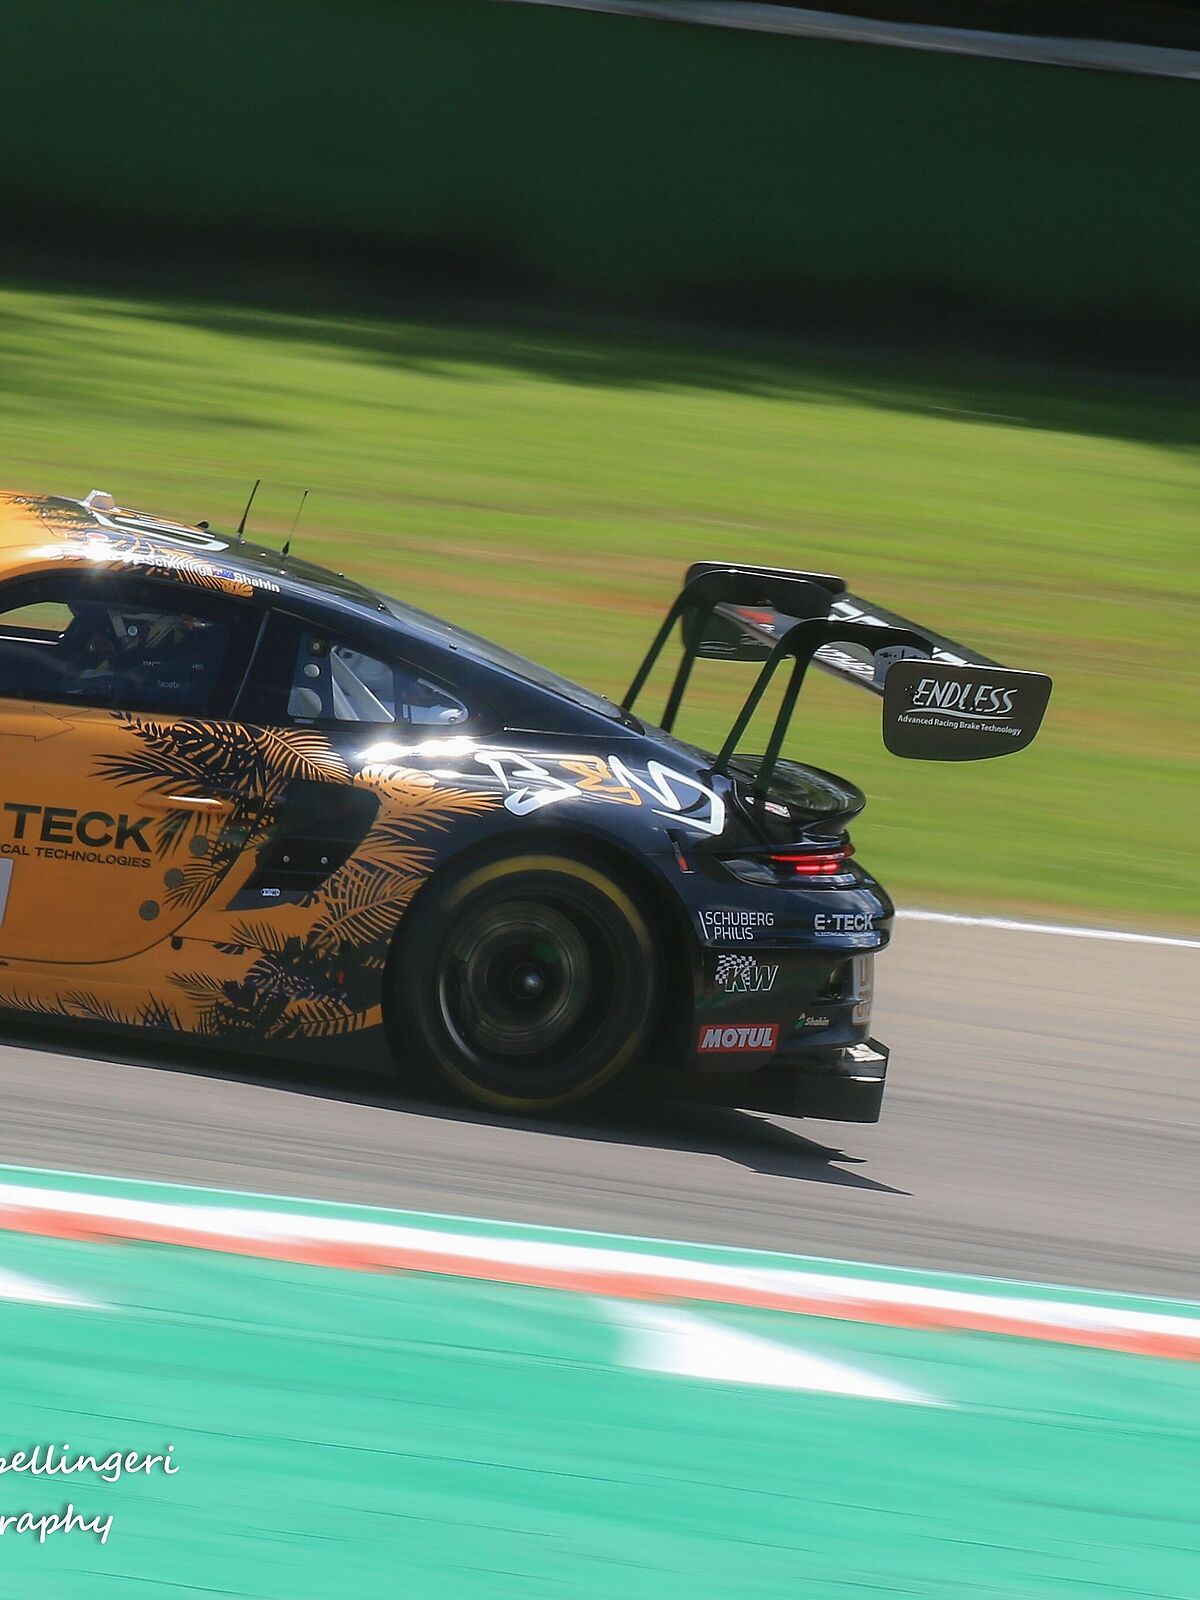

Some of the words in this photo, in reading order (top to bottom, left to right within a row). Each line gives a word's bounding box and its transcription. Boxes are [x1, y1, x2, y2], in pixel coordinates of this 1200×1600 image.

[913, 679, 1018, 714] ENDLESS
[897, 714, 934, 725] Advanced
[934, 719, 959, 729] Racing
[959, 721, 980, 731] Brake
[981, 723, 1022, 736] Technology
[35, 846, 152, 868] TECHNOLOGIES
[705, 911, 775, 926] SCHUBERG
[714, 927, 754, 940] PHILIS
[725, 964, 779, 992] KW
[702, 1027, 773, 1049] MOTUL
